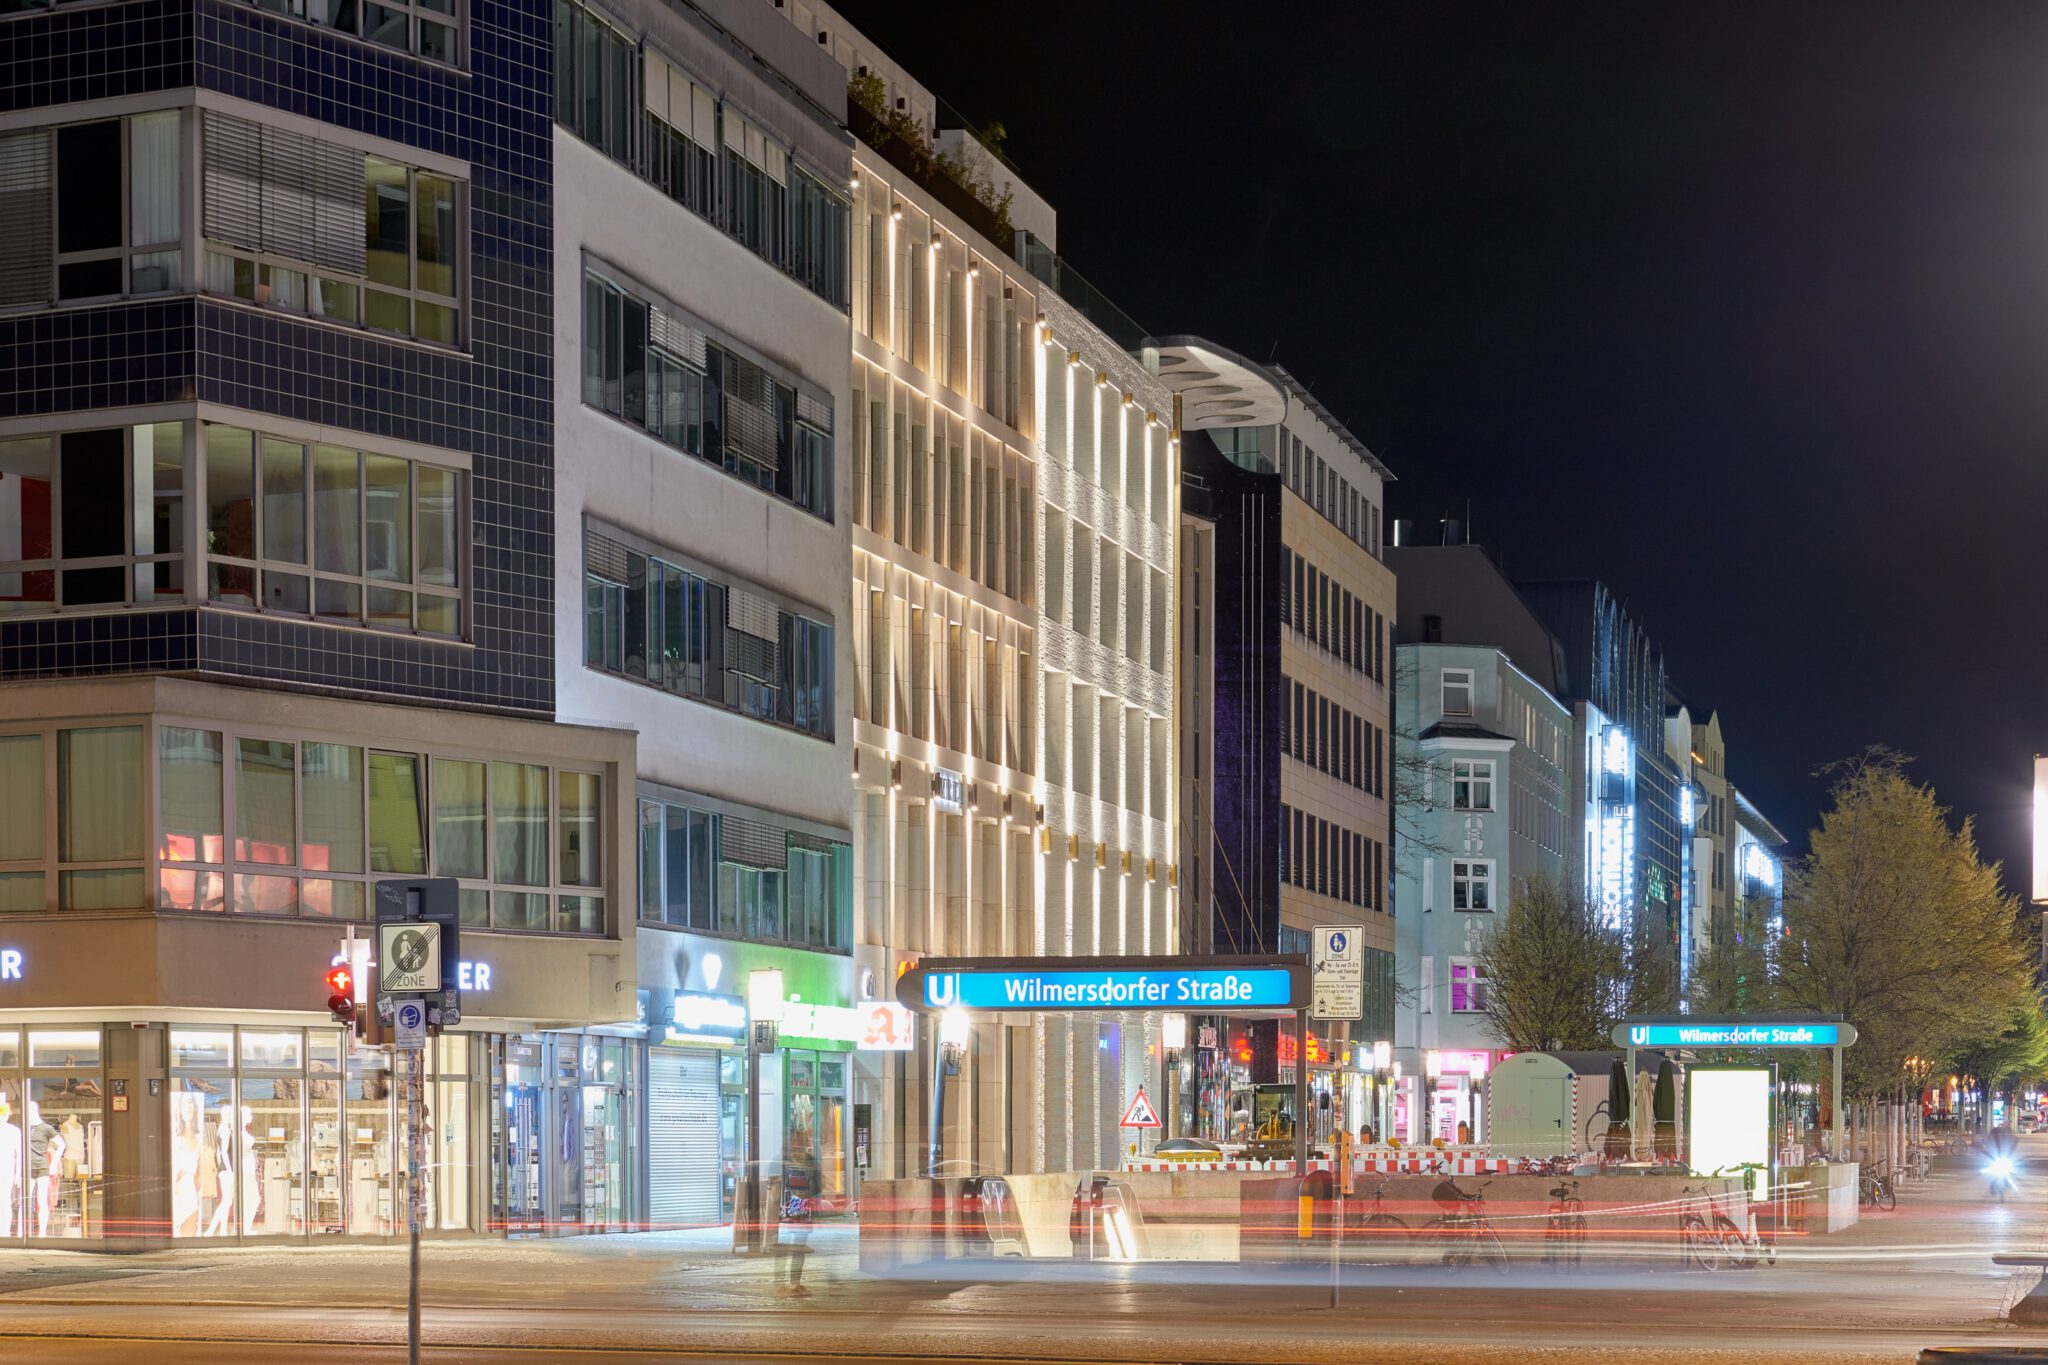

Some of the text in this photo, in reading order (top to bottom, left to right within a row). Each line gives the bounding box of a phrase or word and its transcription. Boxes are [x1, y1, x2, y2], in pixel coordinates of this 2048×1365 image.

[396, 976, 425, 987] ZONE
[928, 975, 1253, 1005] U Wilmersdorfer Straße
[1679, 1027, 1769, 1043] Wilmersdorfer
[1772, 1027, 1814, 1042] Straße
